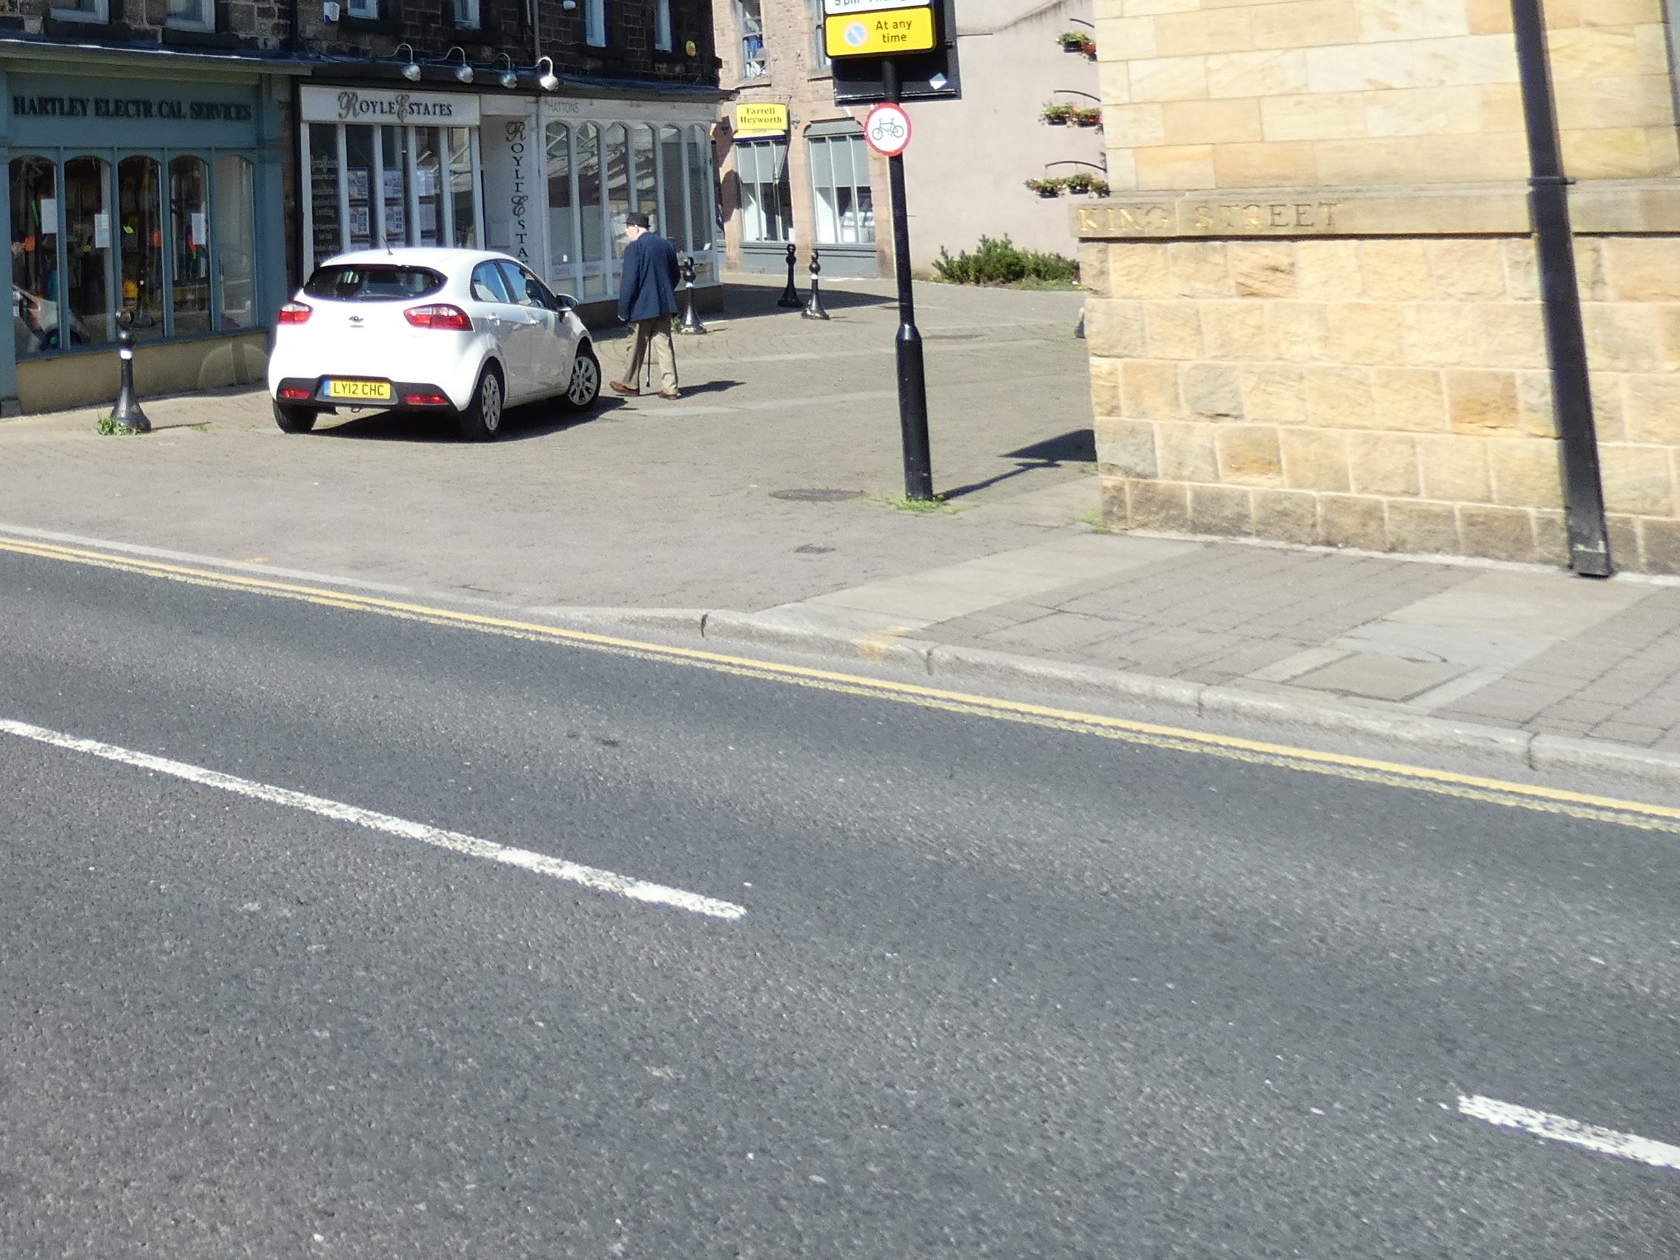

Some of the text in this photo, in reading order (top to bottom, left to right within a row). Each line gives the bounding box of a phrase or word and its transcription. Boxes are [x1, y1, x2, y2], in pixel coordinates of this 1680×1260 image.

[875, 20, 912, 30] At any
[882, 33, 907, 43] time
[13, 96, 252, 121] HARTLEY ELECTRCAL SERVICES
[746, 107, 776, 115] Farrell
[740, 116, 783, 125] Heyworth
[1078, 202, 1342, 231] KING STREET
[333, 382, 385, 396] LY12 CHC
